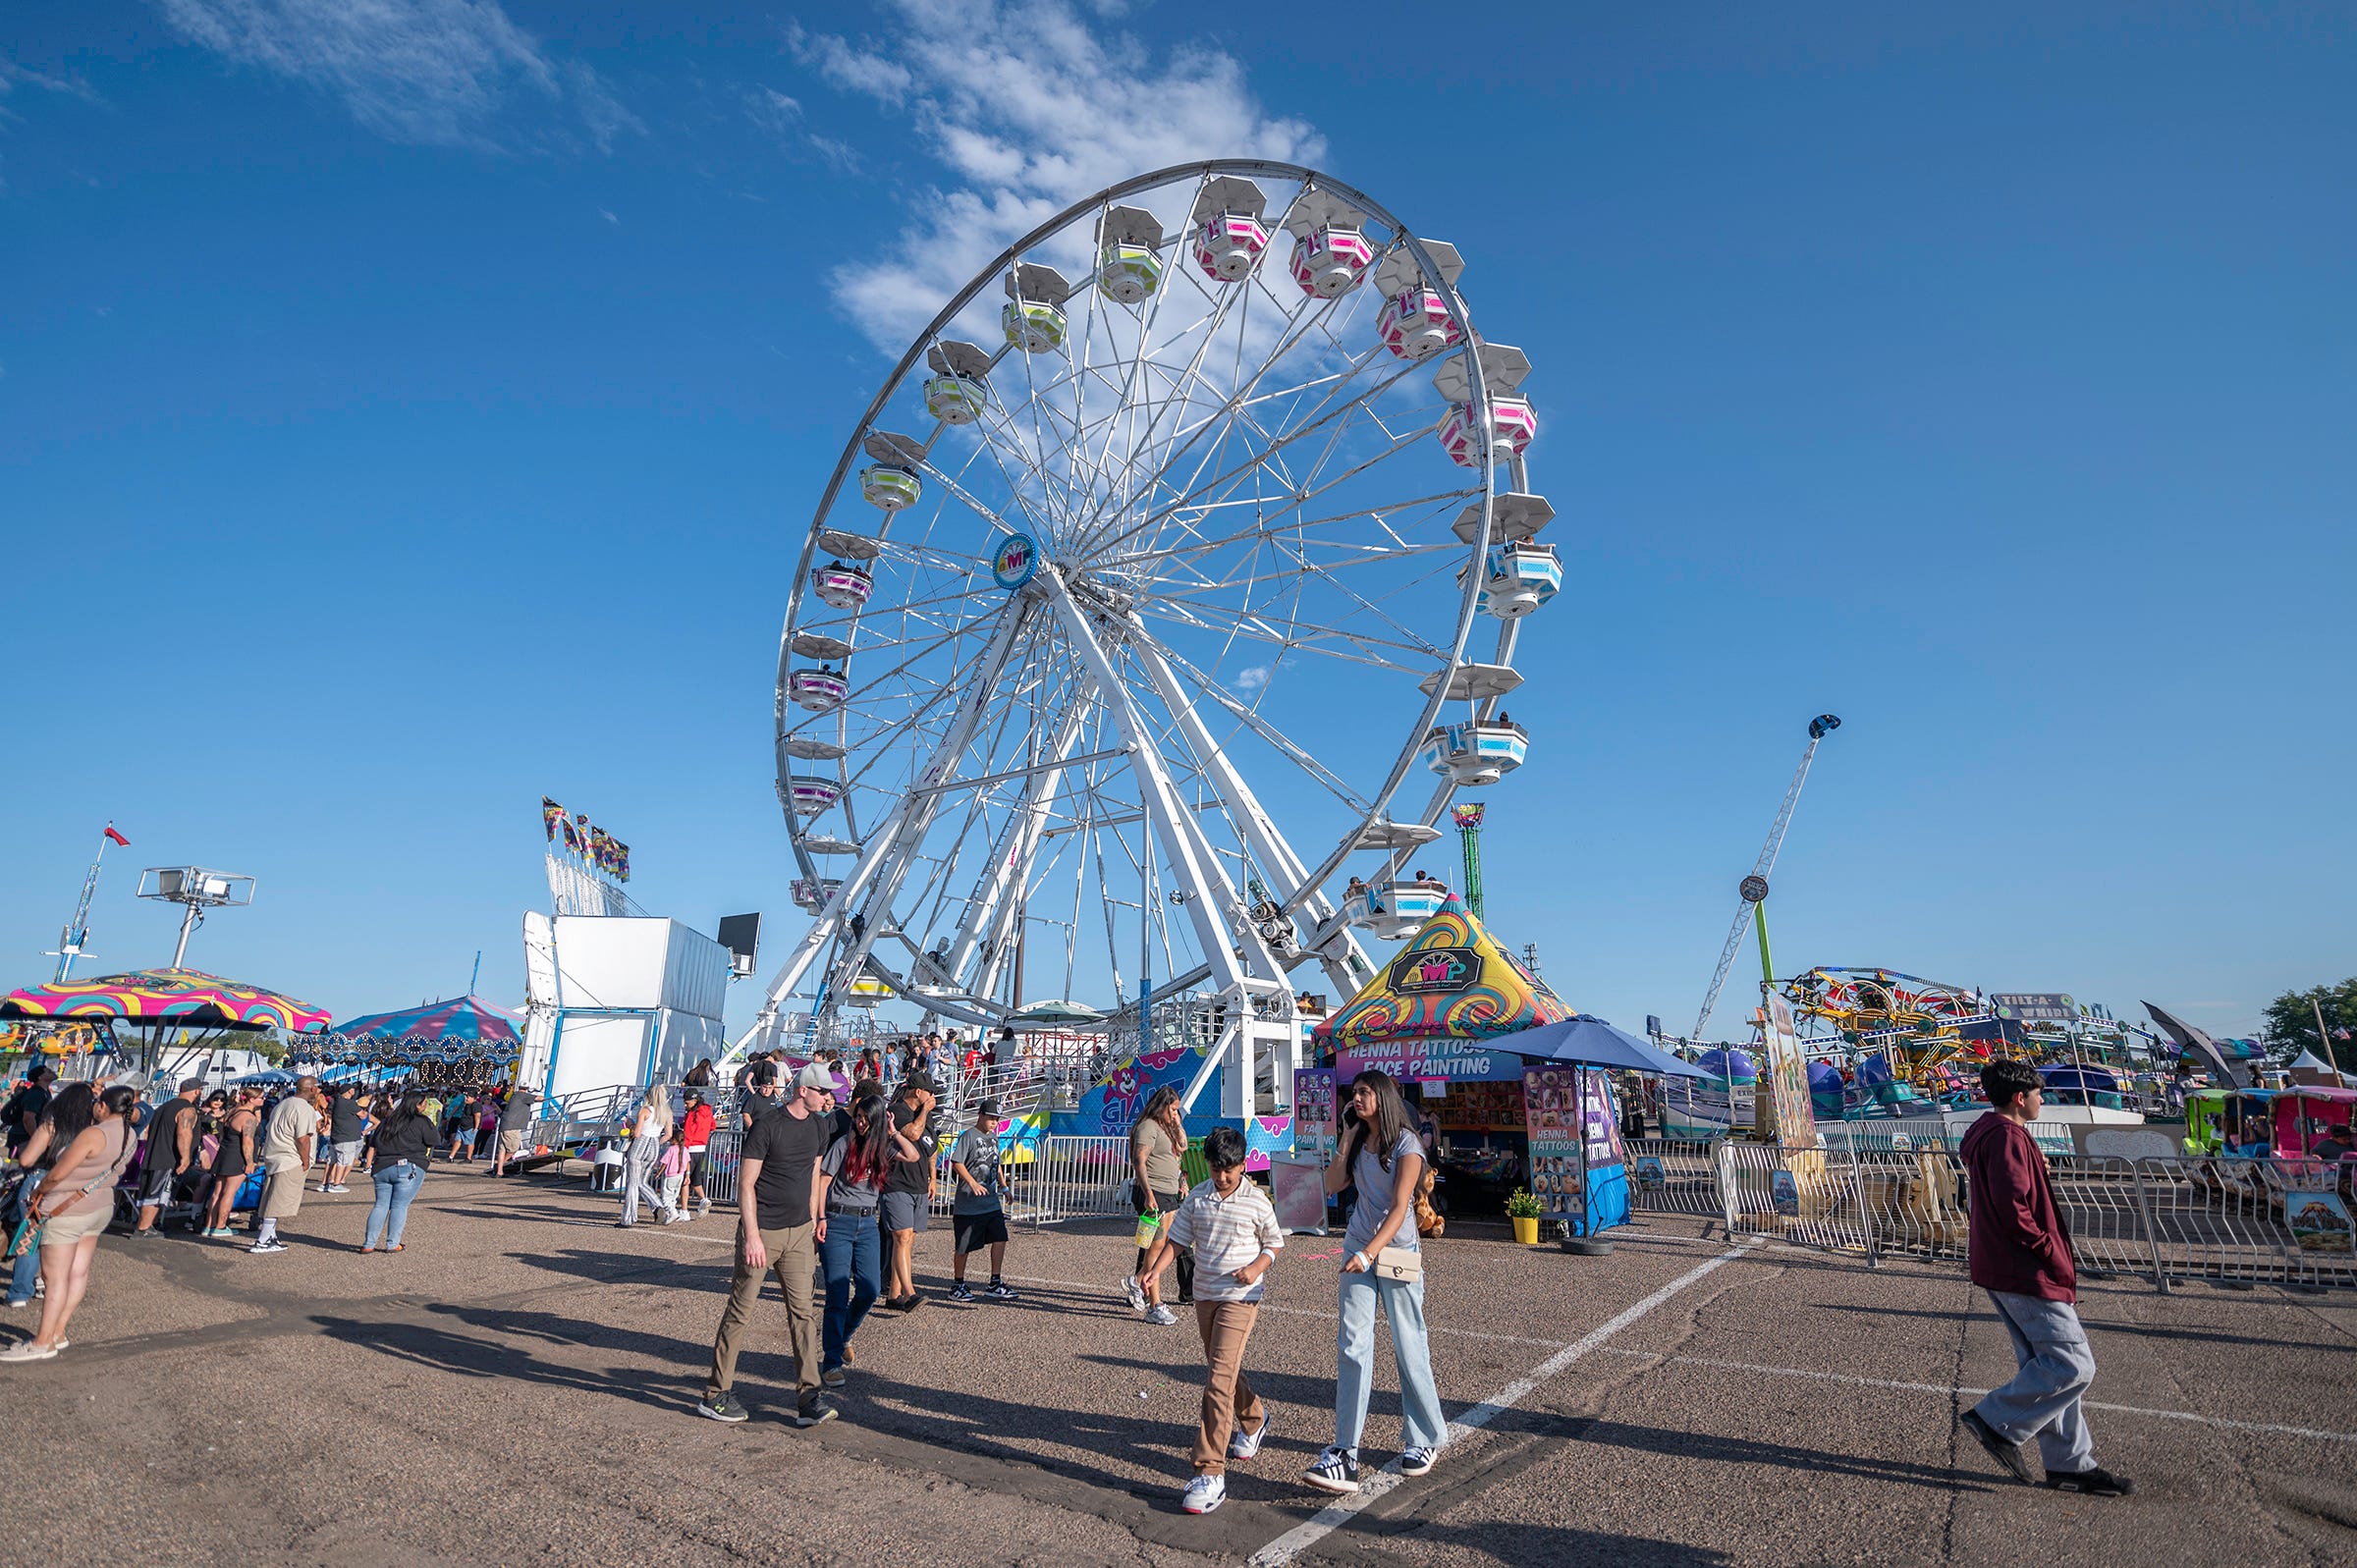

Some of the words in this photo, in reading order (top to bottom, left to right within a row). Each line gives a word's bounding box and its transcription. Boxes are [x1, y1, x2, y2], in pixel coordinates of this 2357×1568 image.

[1401, 962, 1466, 984] AMP
[1348, 1041, 1402, 1058] HENNA
[1409, 1057, 1491, 1076] PAINTING
[1295, 1135, 1334, 1146] PAINNG
[1537, 1130, 1568, 1139] HENNA
[1532, 1141, 1576, 1152] TATTOOS
[1587, 1141, 1612, 1161] TATTOOS
